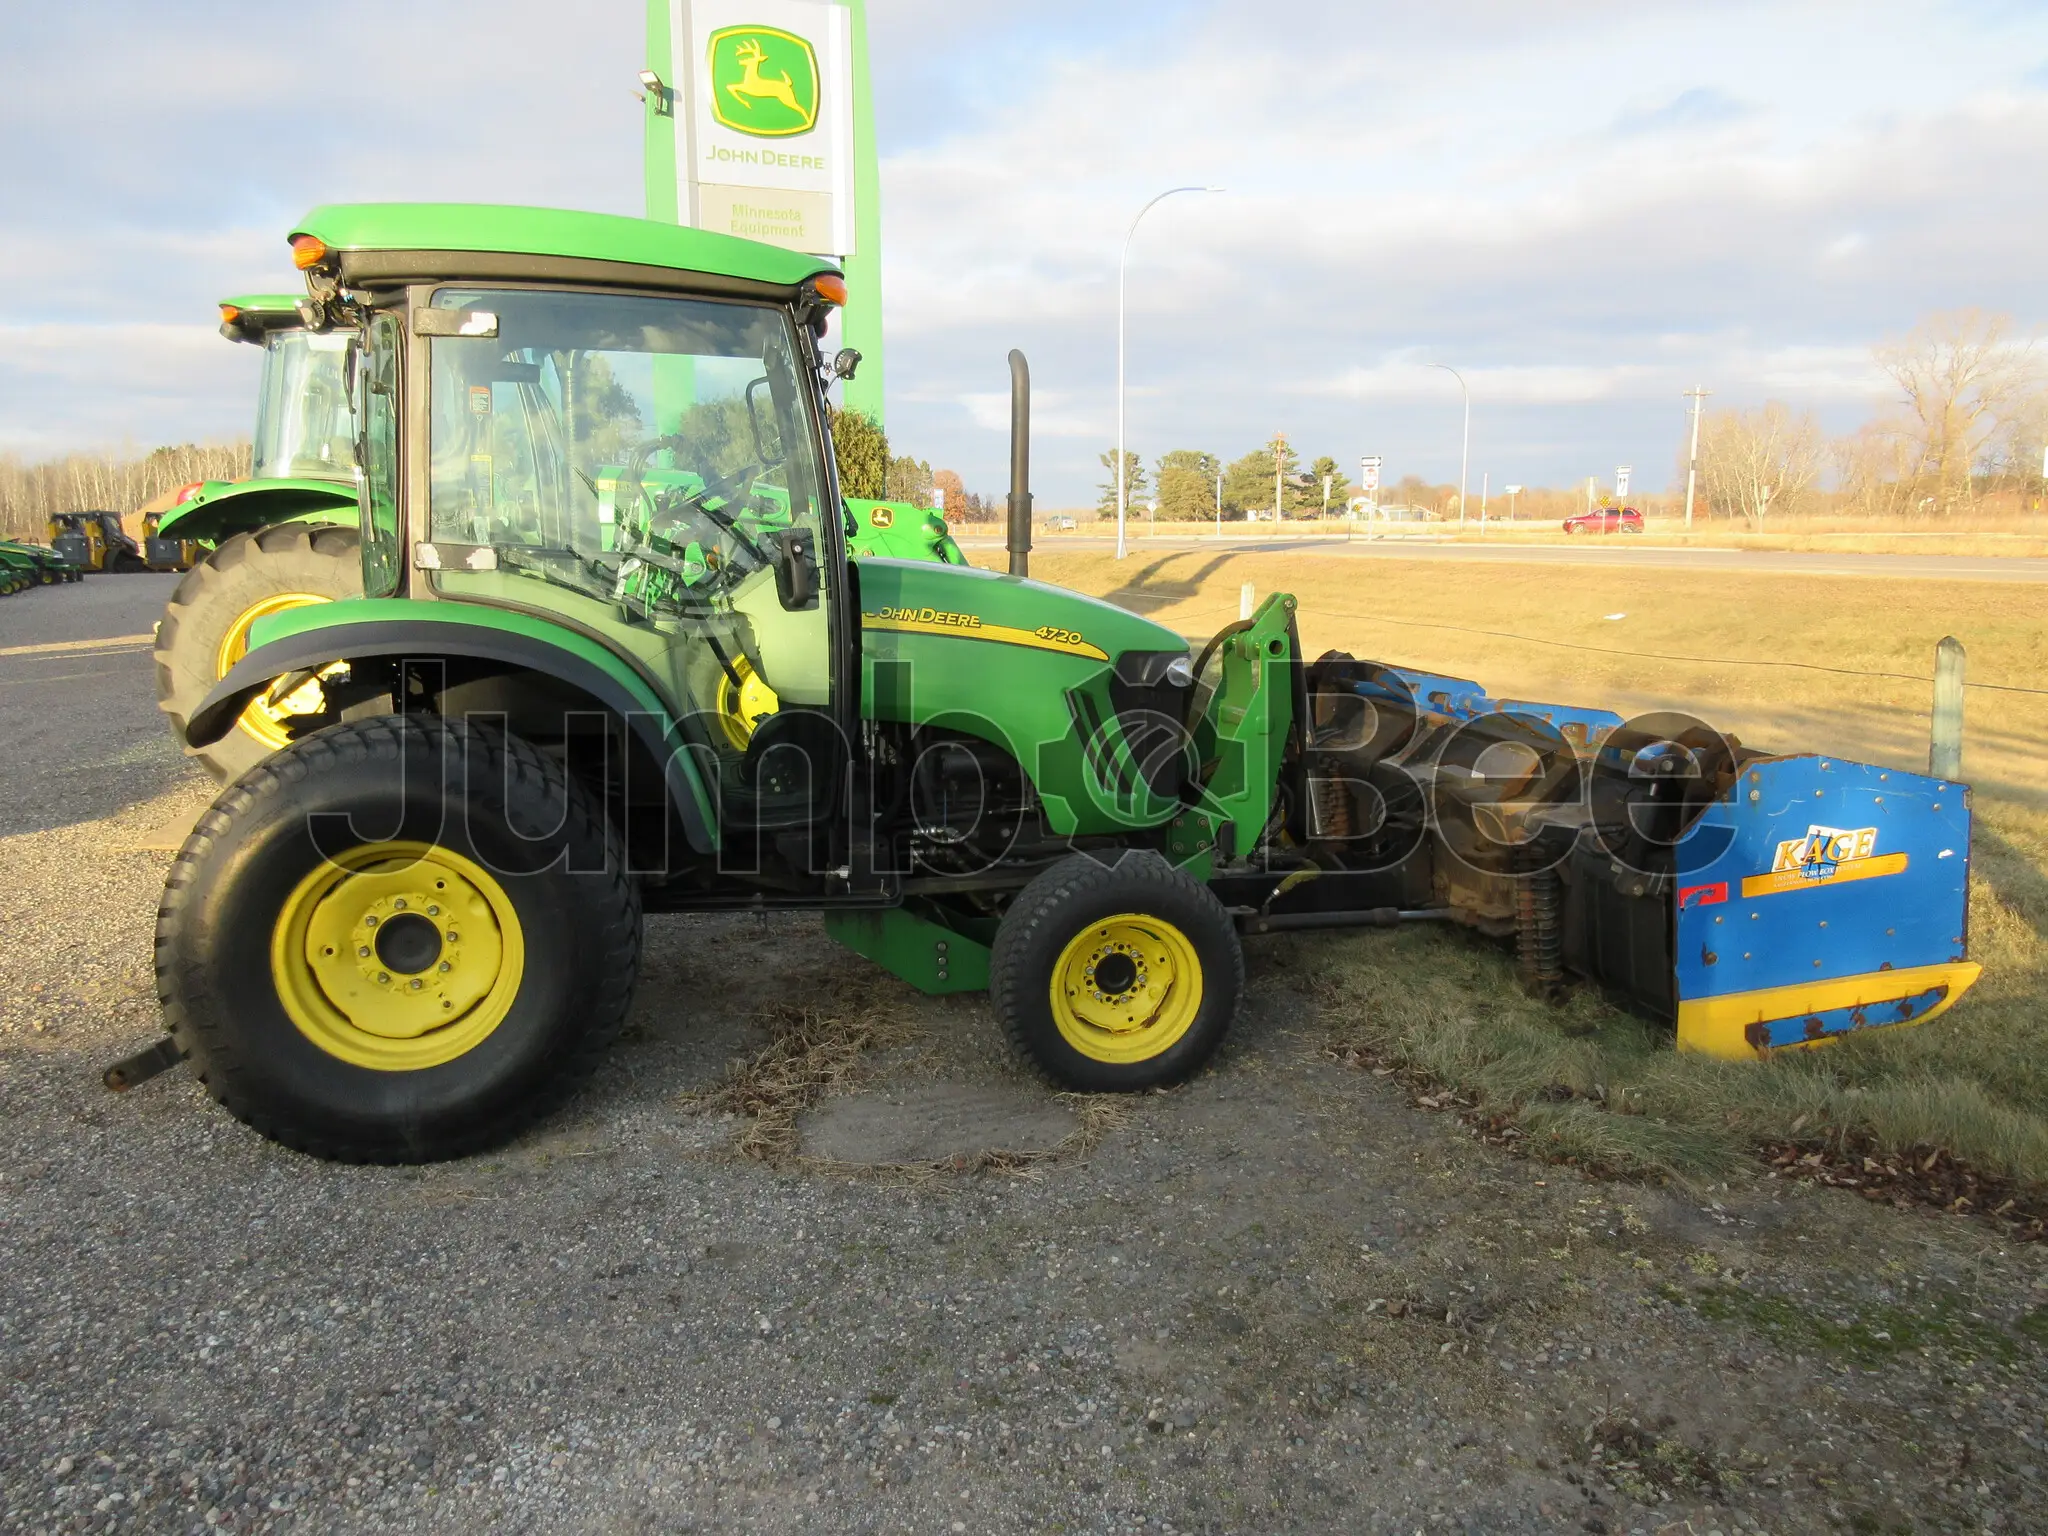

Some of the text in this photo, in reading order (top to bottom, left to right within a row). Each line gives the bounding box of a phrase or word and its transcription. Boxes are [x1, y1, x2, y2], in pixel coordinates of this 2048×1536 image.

[706, 145, 825, 169] JOHN DEERE
[732, 204, 801, 221] Minnesota
[731, 220, 804, 237] Equipment
[919, 607, 981, 628] DEERE
[1036, 625, 1082, 644] 4720
[1776, 829, 1874, 869] KAGE
[1819, 866, 1835, 875] BOX
